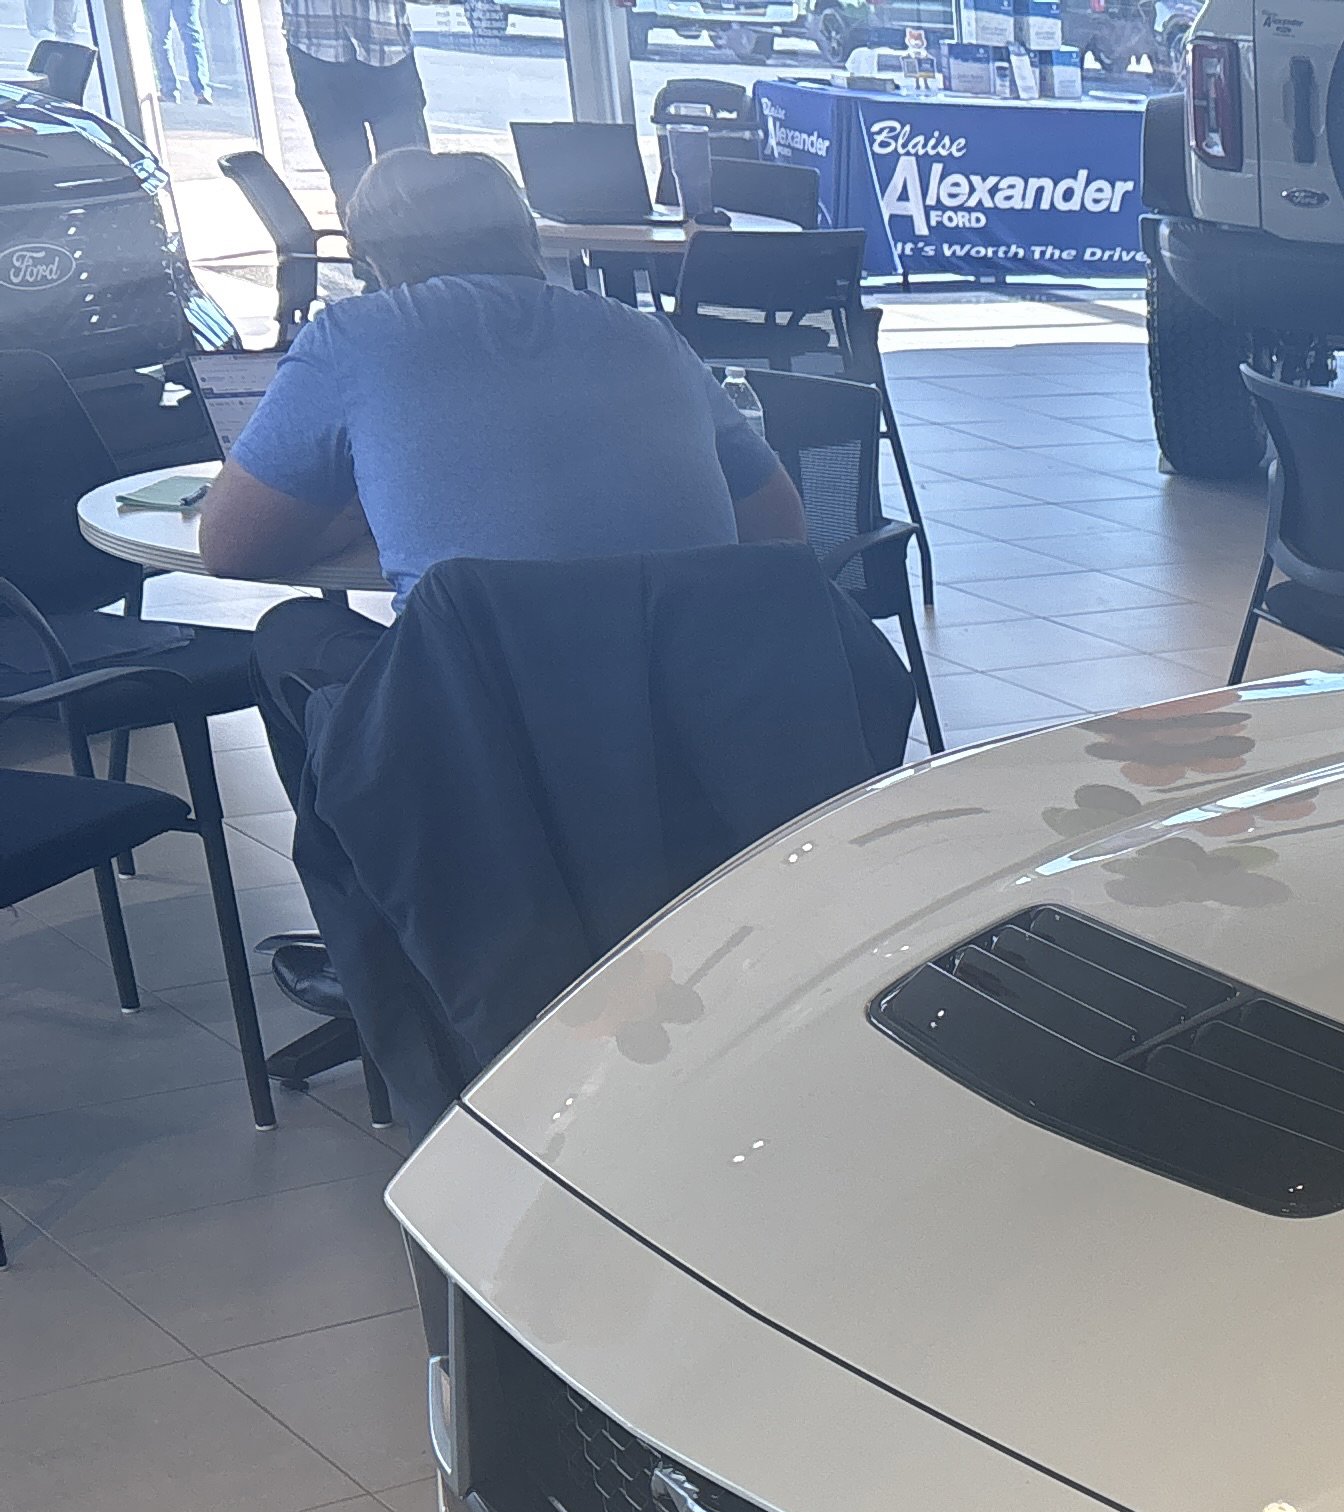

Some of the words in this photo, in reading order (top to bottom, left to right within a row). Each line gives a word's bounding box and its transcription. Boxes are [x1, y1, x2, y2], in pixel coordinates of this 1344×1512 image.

[764, 116, 830, 158] Alexander
[870, 120, 967, 157] Blaise
[883, 155, 1134, 236] Alexander
[930, 211, 986, 229] FORD
[10, 251, 59, 283] Ford
[897, 242, 936, 256] It's
[942, 243, 1024, 259] Worth
[1031, 245, 1076, 261] The
